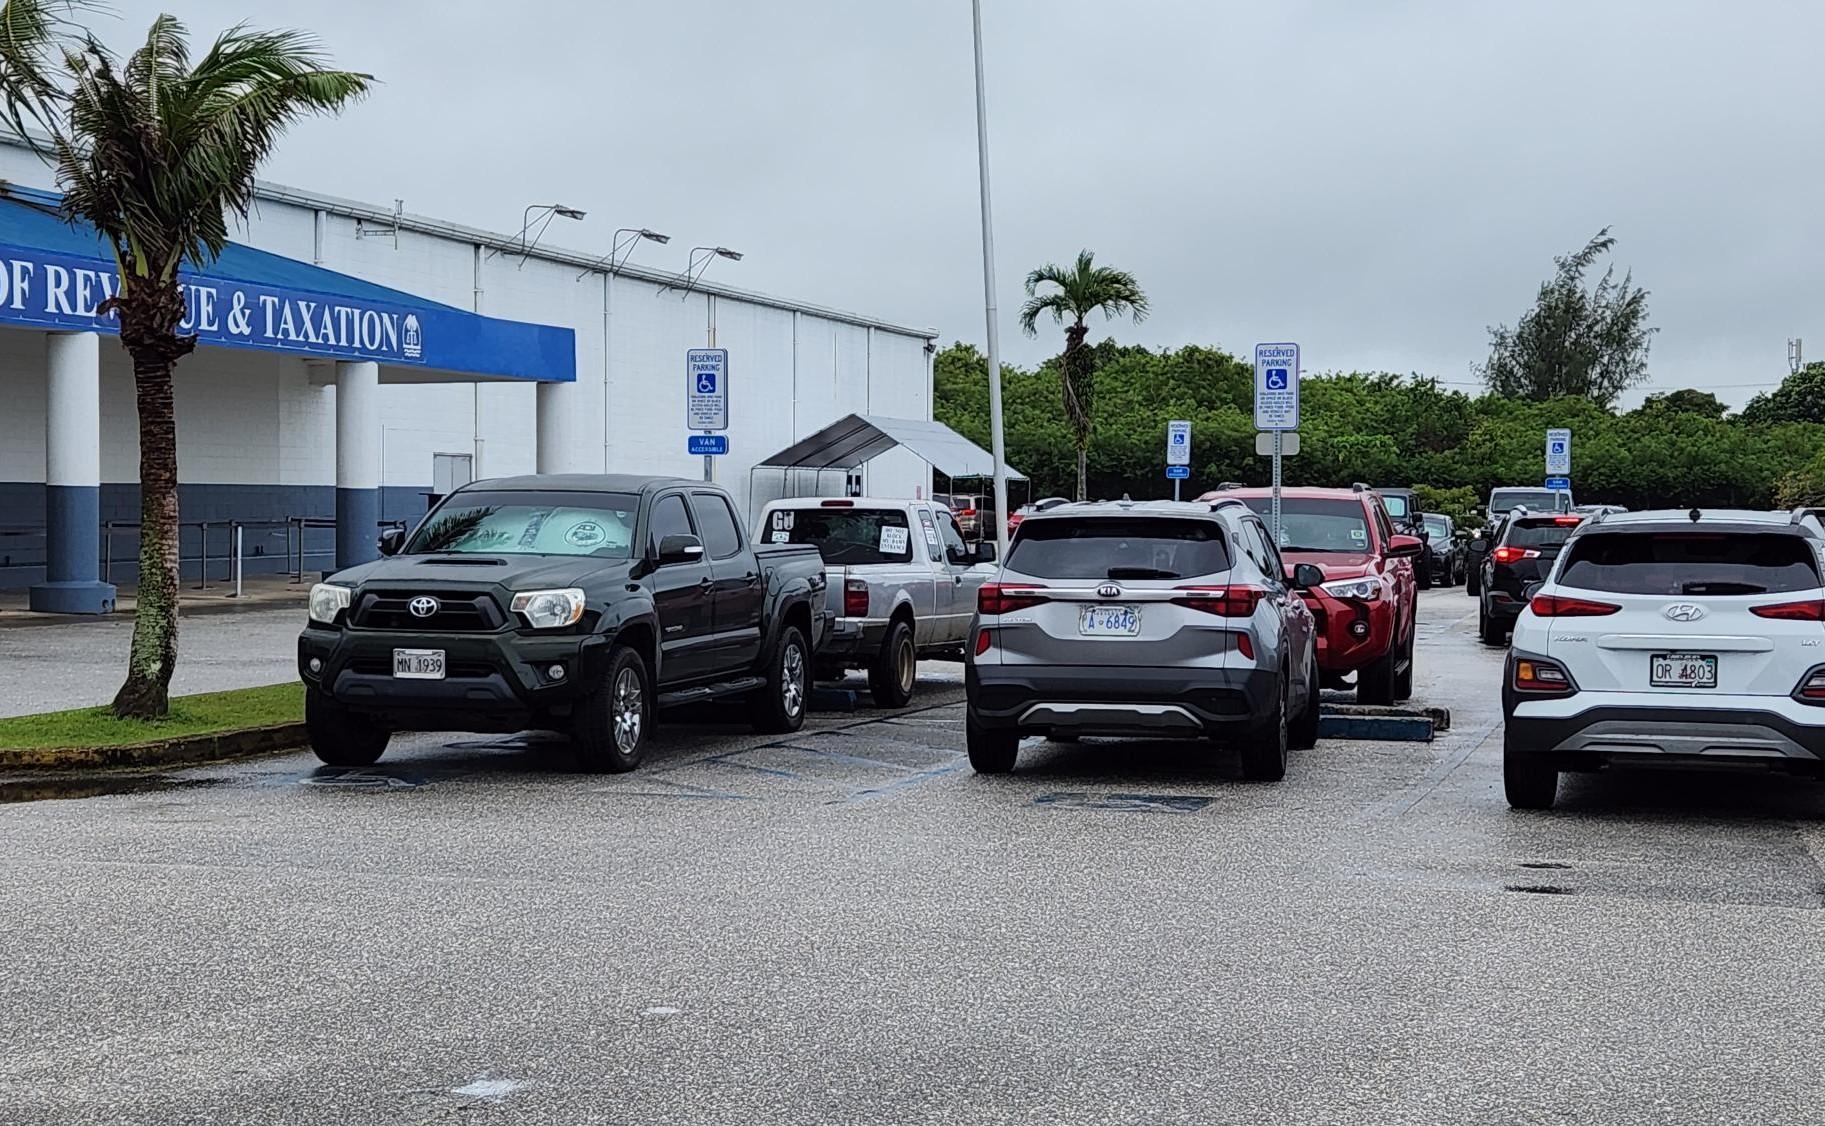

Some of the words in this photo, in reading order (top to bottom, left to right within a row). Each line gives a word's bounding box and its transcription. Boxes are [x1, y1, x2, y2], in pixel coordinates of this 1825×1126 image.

[43, 264, 218, 332] REVUE
[227, 291, 252, 335] &
[260, 295, 398, 352] TAXATION
[1259, 349, 1295, 358] RESERVED
[690, 354, 722, 363] RESERVED
[1262, 359, 1292, 367] PARKING
[693, 364, 720, 372] PARKING
[699, 438, 716, 446] VAN
[1100, 587, 1118, 596] KIA
[1088, 612, 1095, 629] A
[1106, 614, 1135, 632] 6849
[397, 657, 411, 672] MN
[416, 657, 443, 673] 1939
[1655, 663, 1672, 679] OR
[1679, 664, 1714, 680] 4803
